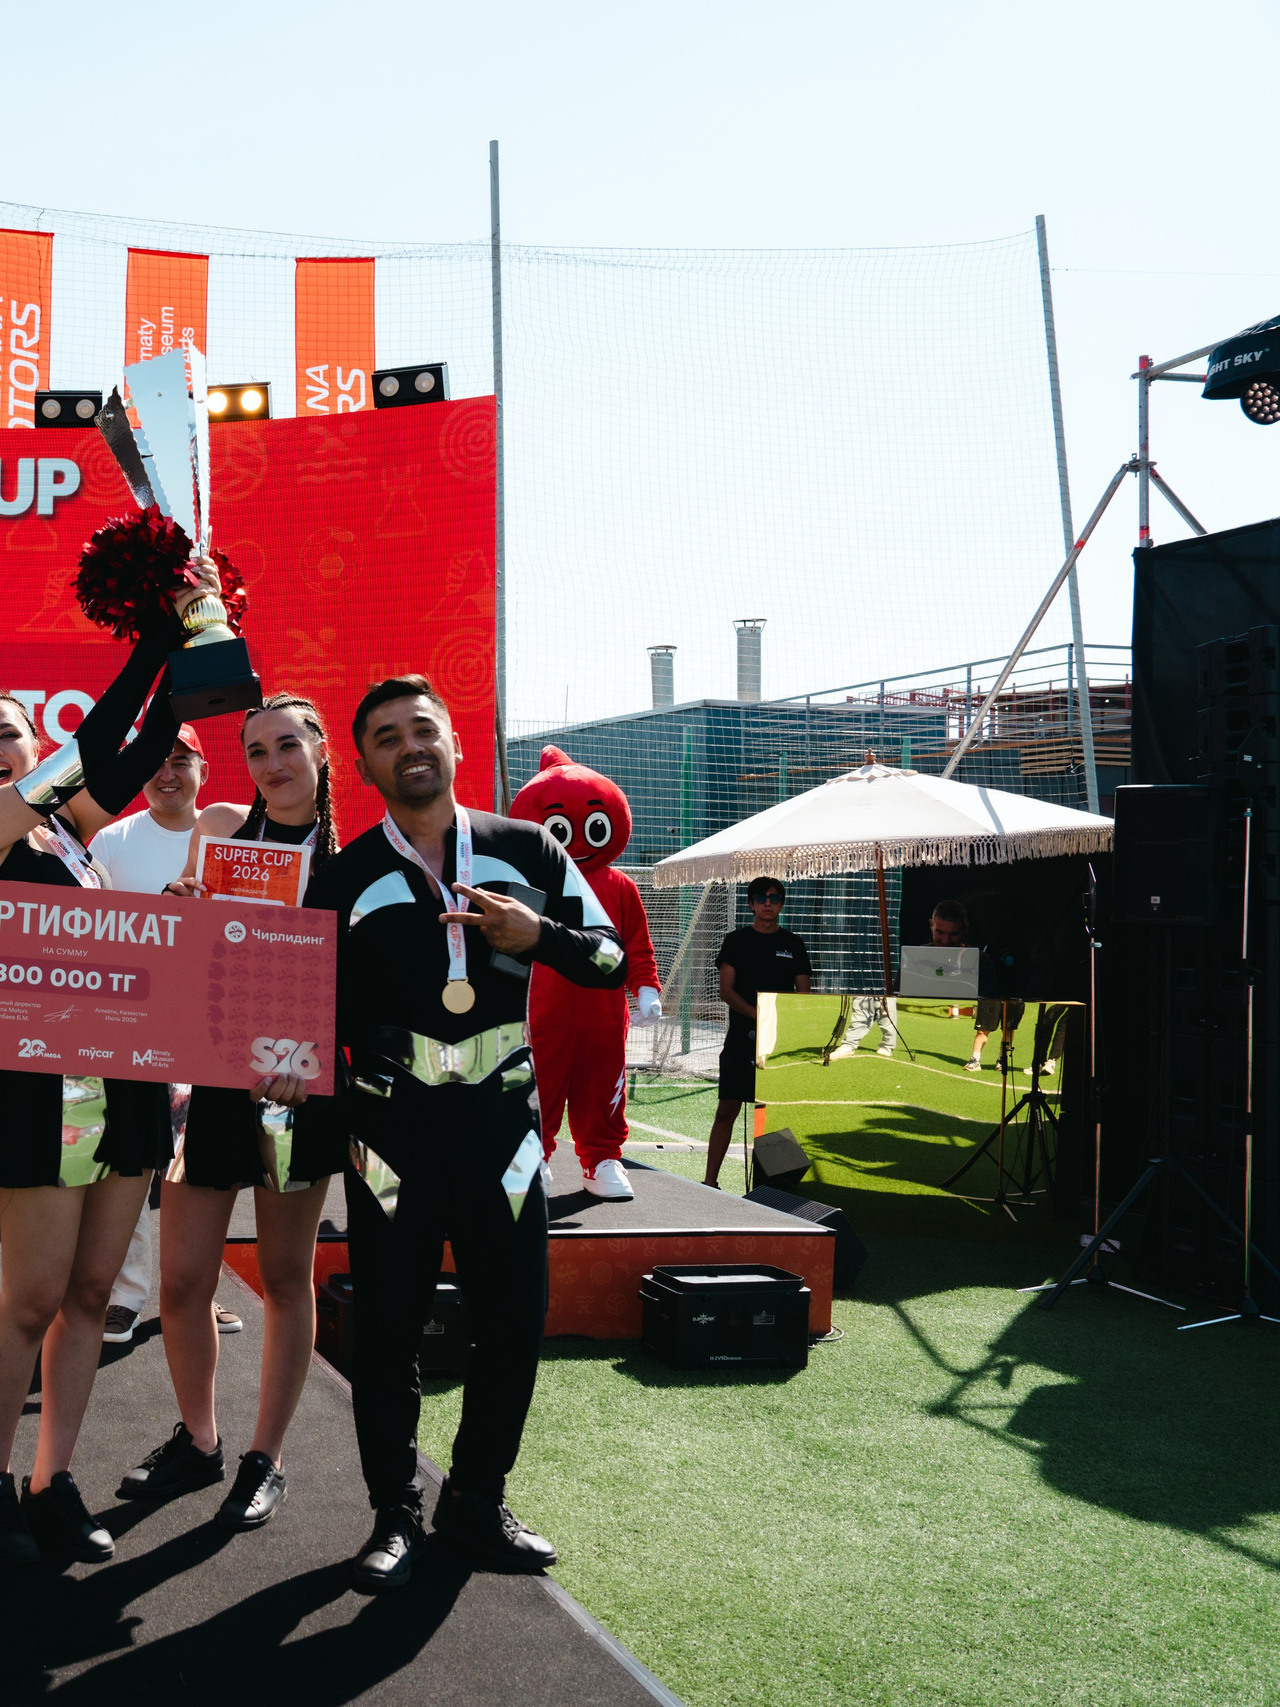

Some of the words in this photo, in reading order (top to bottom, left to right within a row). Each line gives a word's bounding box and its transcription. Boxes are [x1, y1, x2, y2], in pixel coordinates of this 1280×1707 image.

[7, 299, 41, 429] TORS
[1233, 350, 1264, 367] SKY
[213, 846, 259, 864] SUPER
[262, 851, 293, 867] CUP
[231, 864, 270, 881] 2026
[251, 928, 325, 945] Чирлидинг
[42, 946, 55, 955] НА
[56, 948, 89, 958] СУММУ
[50, 967, 103, 990] 000
[108, 972, 137, 992] ТГ
[122, 1015, 137, 1023] 2026
[152, 1049, 171, 1057] Almaty
[152, 1055, 175, 1063] Museum
